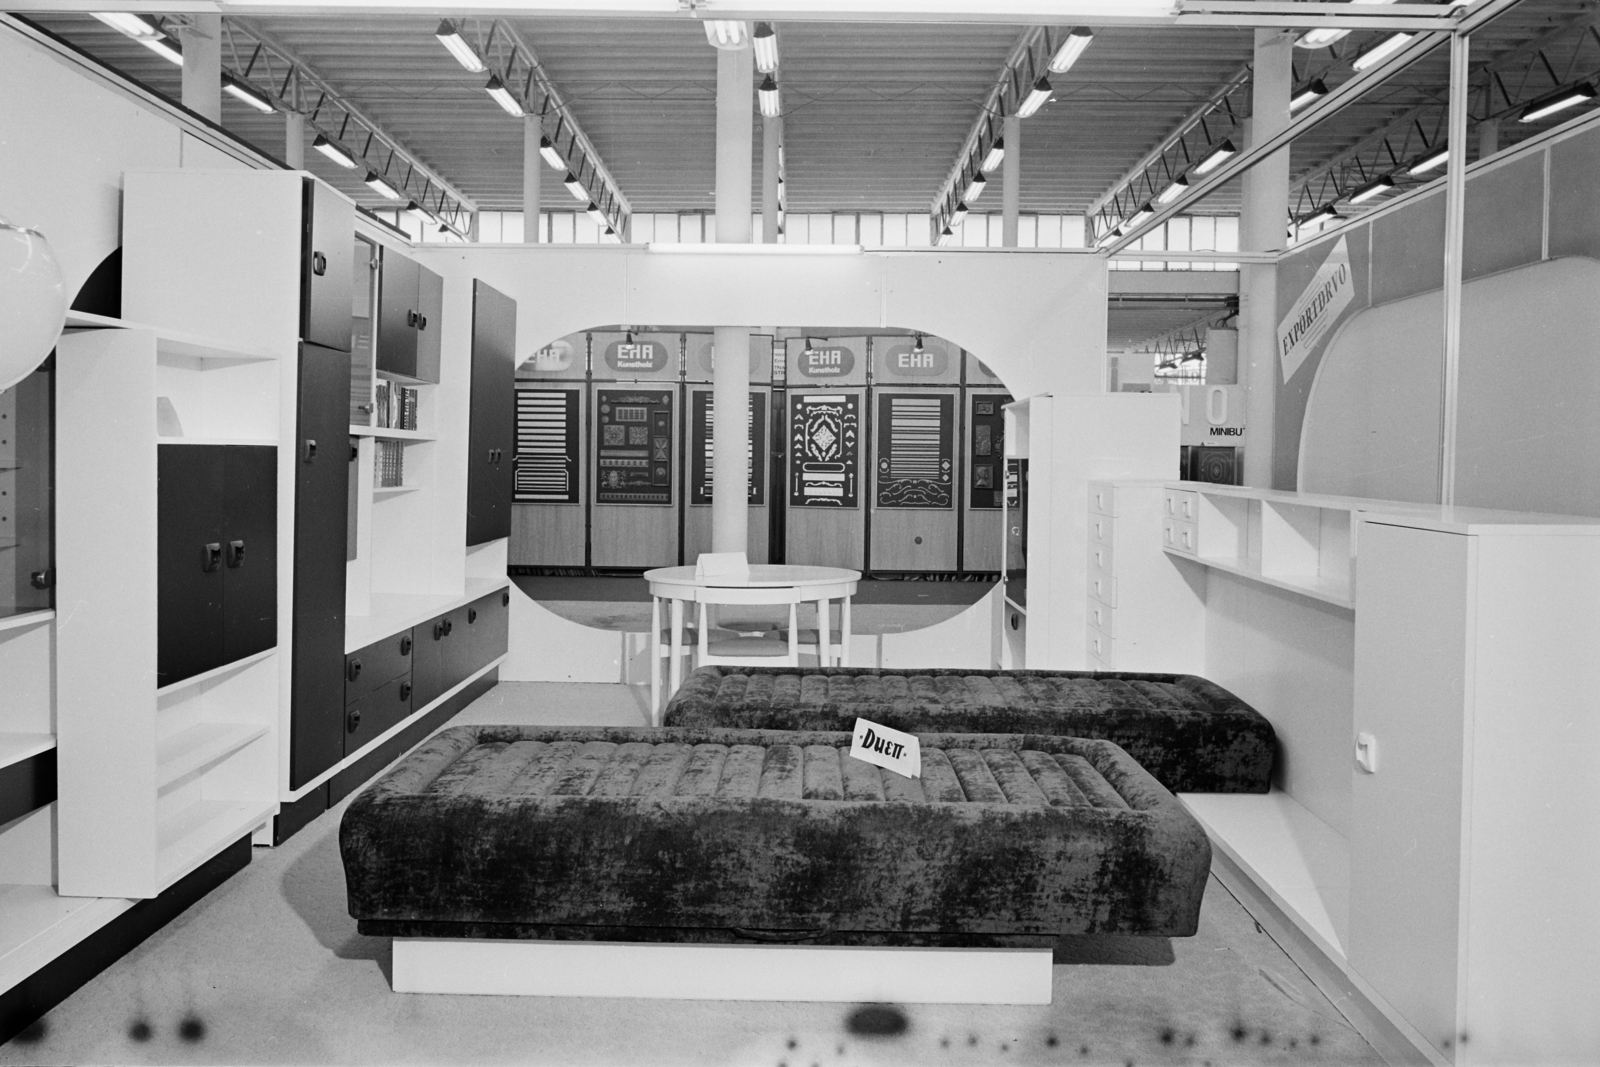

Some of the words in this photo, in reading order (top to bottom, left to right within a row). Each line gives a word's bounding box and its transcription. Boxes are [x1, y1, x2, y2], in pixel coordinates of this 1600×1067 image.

[1282, 263, 1346, 357] EXPORTDRVO
[617, 344, 653, 359] EHA
[808, 350, 841, 365] EHA
[617, 360, 653, 368] Kunstholz
[898, 353, 934, 368] EHA
[808, 366, 841, 374] Kunstholz
[1209, 427, 1246, 436] MINIBU
